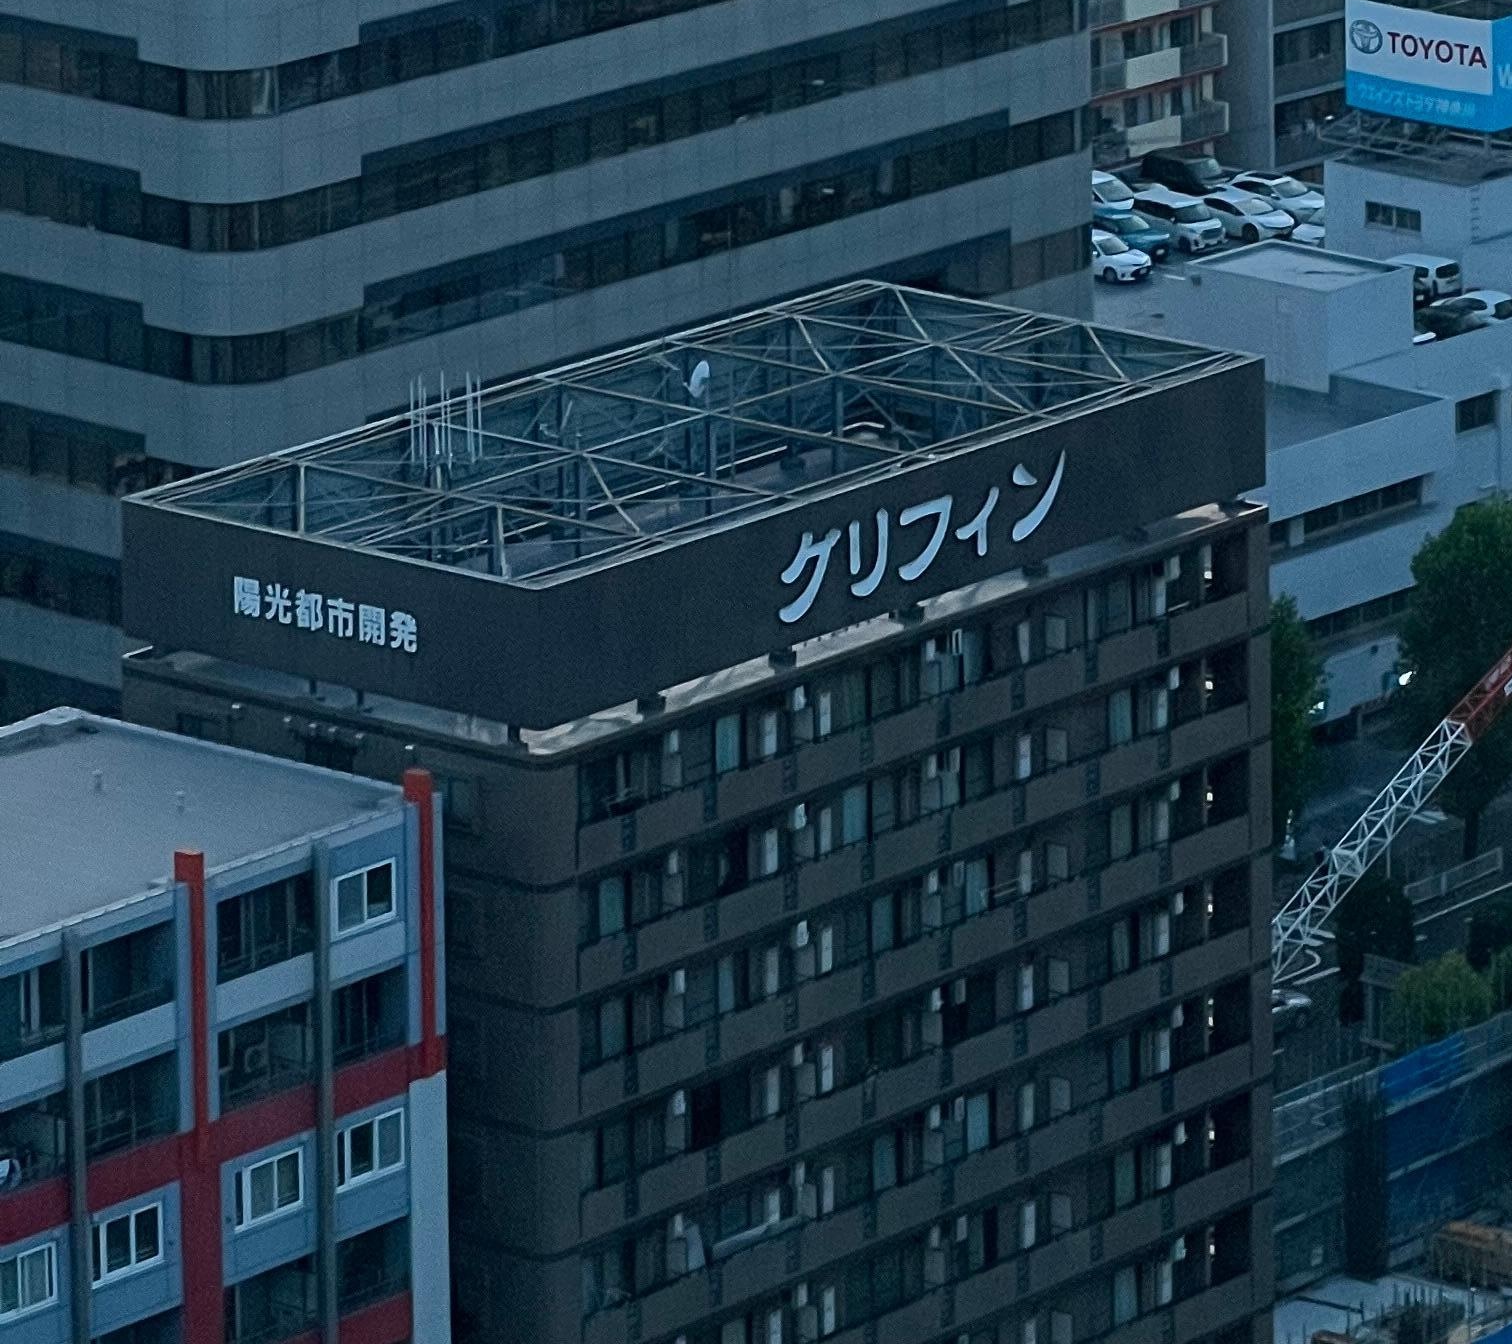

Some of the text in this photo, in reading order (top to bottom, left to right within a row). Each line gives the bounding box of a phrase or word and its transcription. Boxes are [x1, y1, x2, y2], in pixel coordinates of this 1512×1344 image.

[1387, 31, 1488, 69] TOYOTA
[779, 449, 1066, 623] グリフィン
[233, 576, 418, 653] 陽光都市開発
